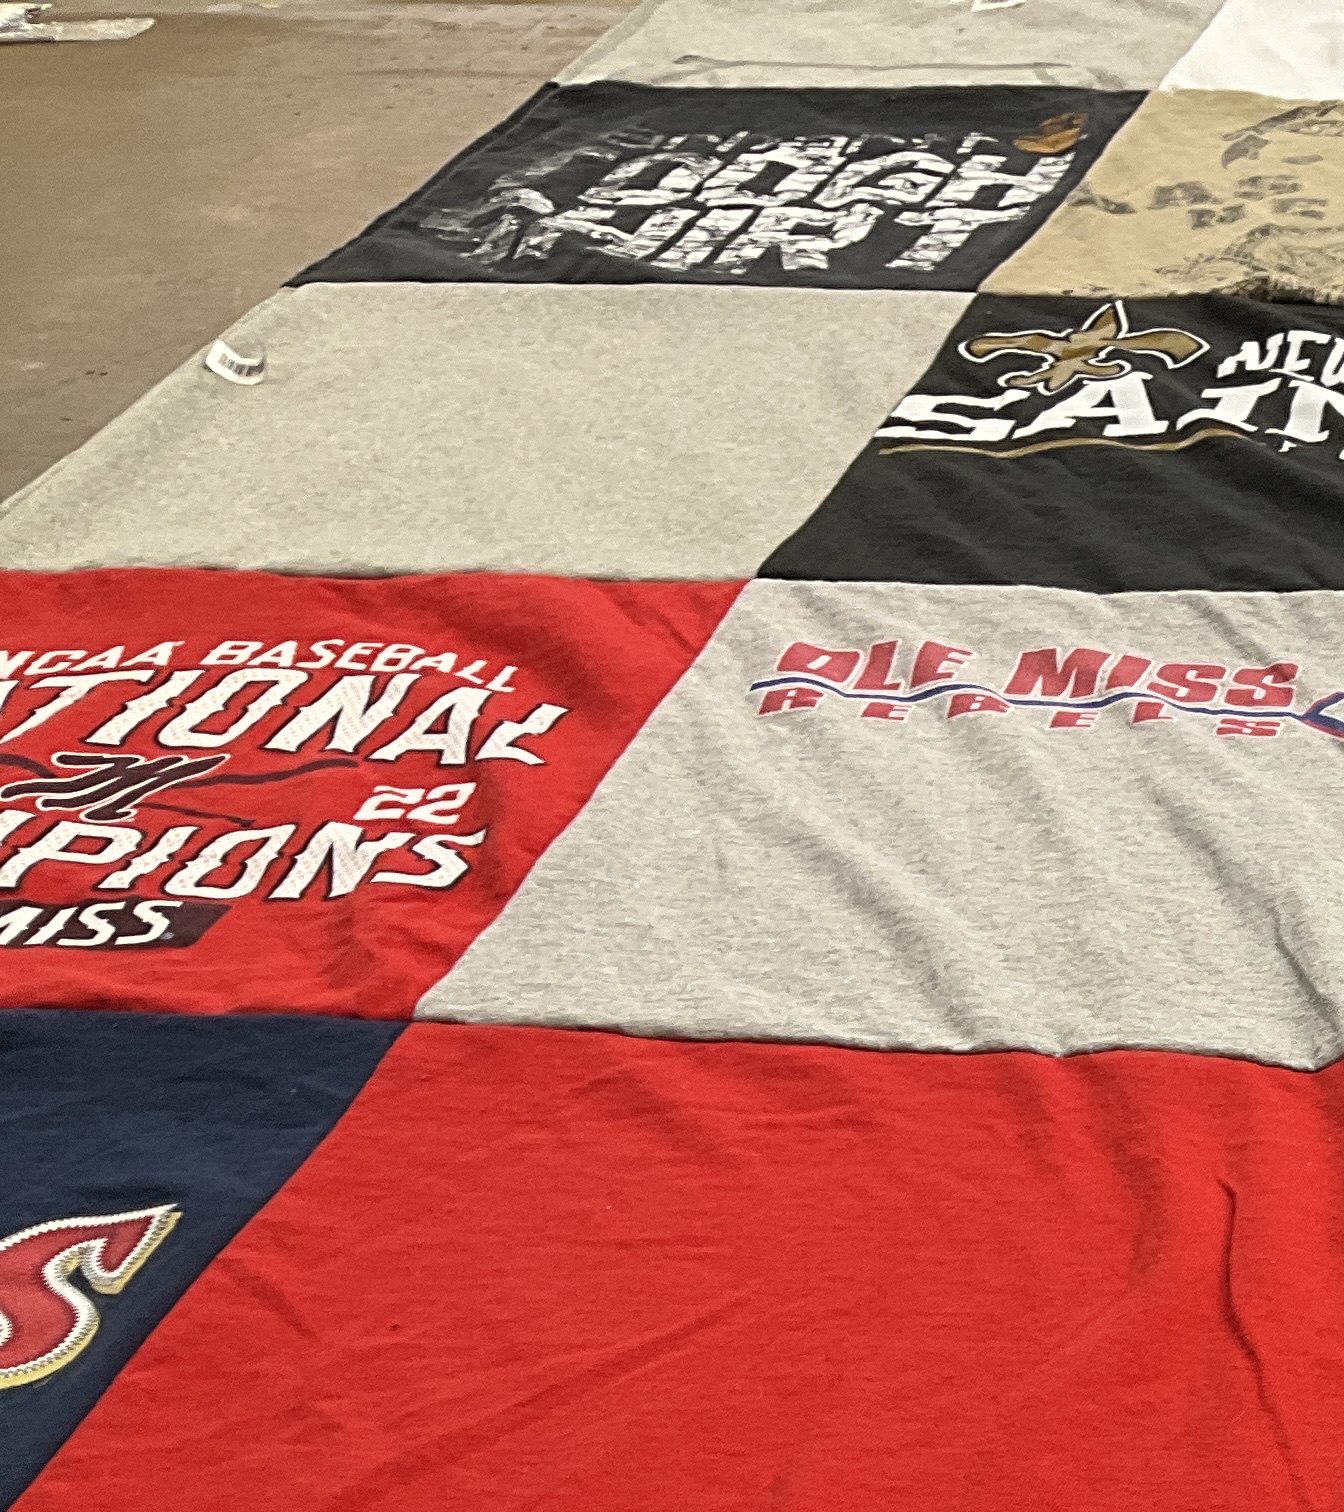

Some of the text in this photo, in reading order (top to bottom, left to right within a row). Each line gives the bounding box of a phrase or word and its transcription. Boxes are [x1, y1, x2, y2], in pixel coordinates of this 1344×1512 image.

[201, 639, 520, 693] BASEBALL
[775, 640, 1302, 709] OLE MISS
[0, 668, 568, 768] TIONAL
[758, 687, 1288, 739] REBELS
[353, 781, 476, 825] 22
[0, 808, 487, 900] PIONS
